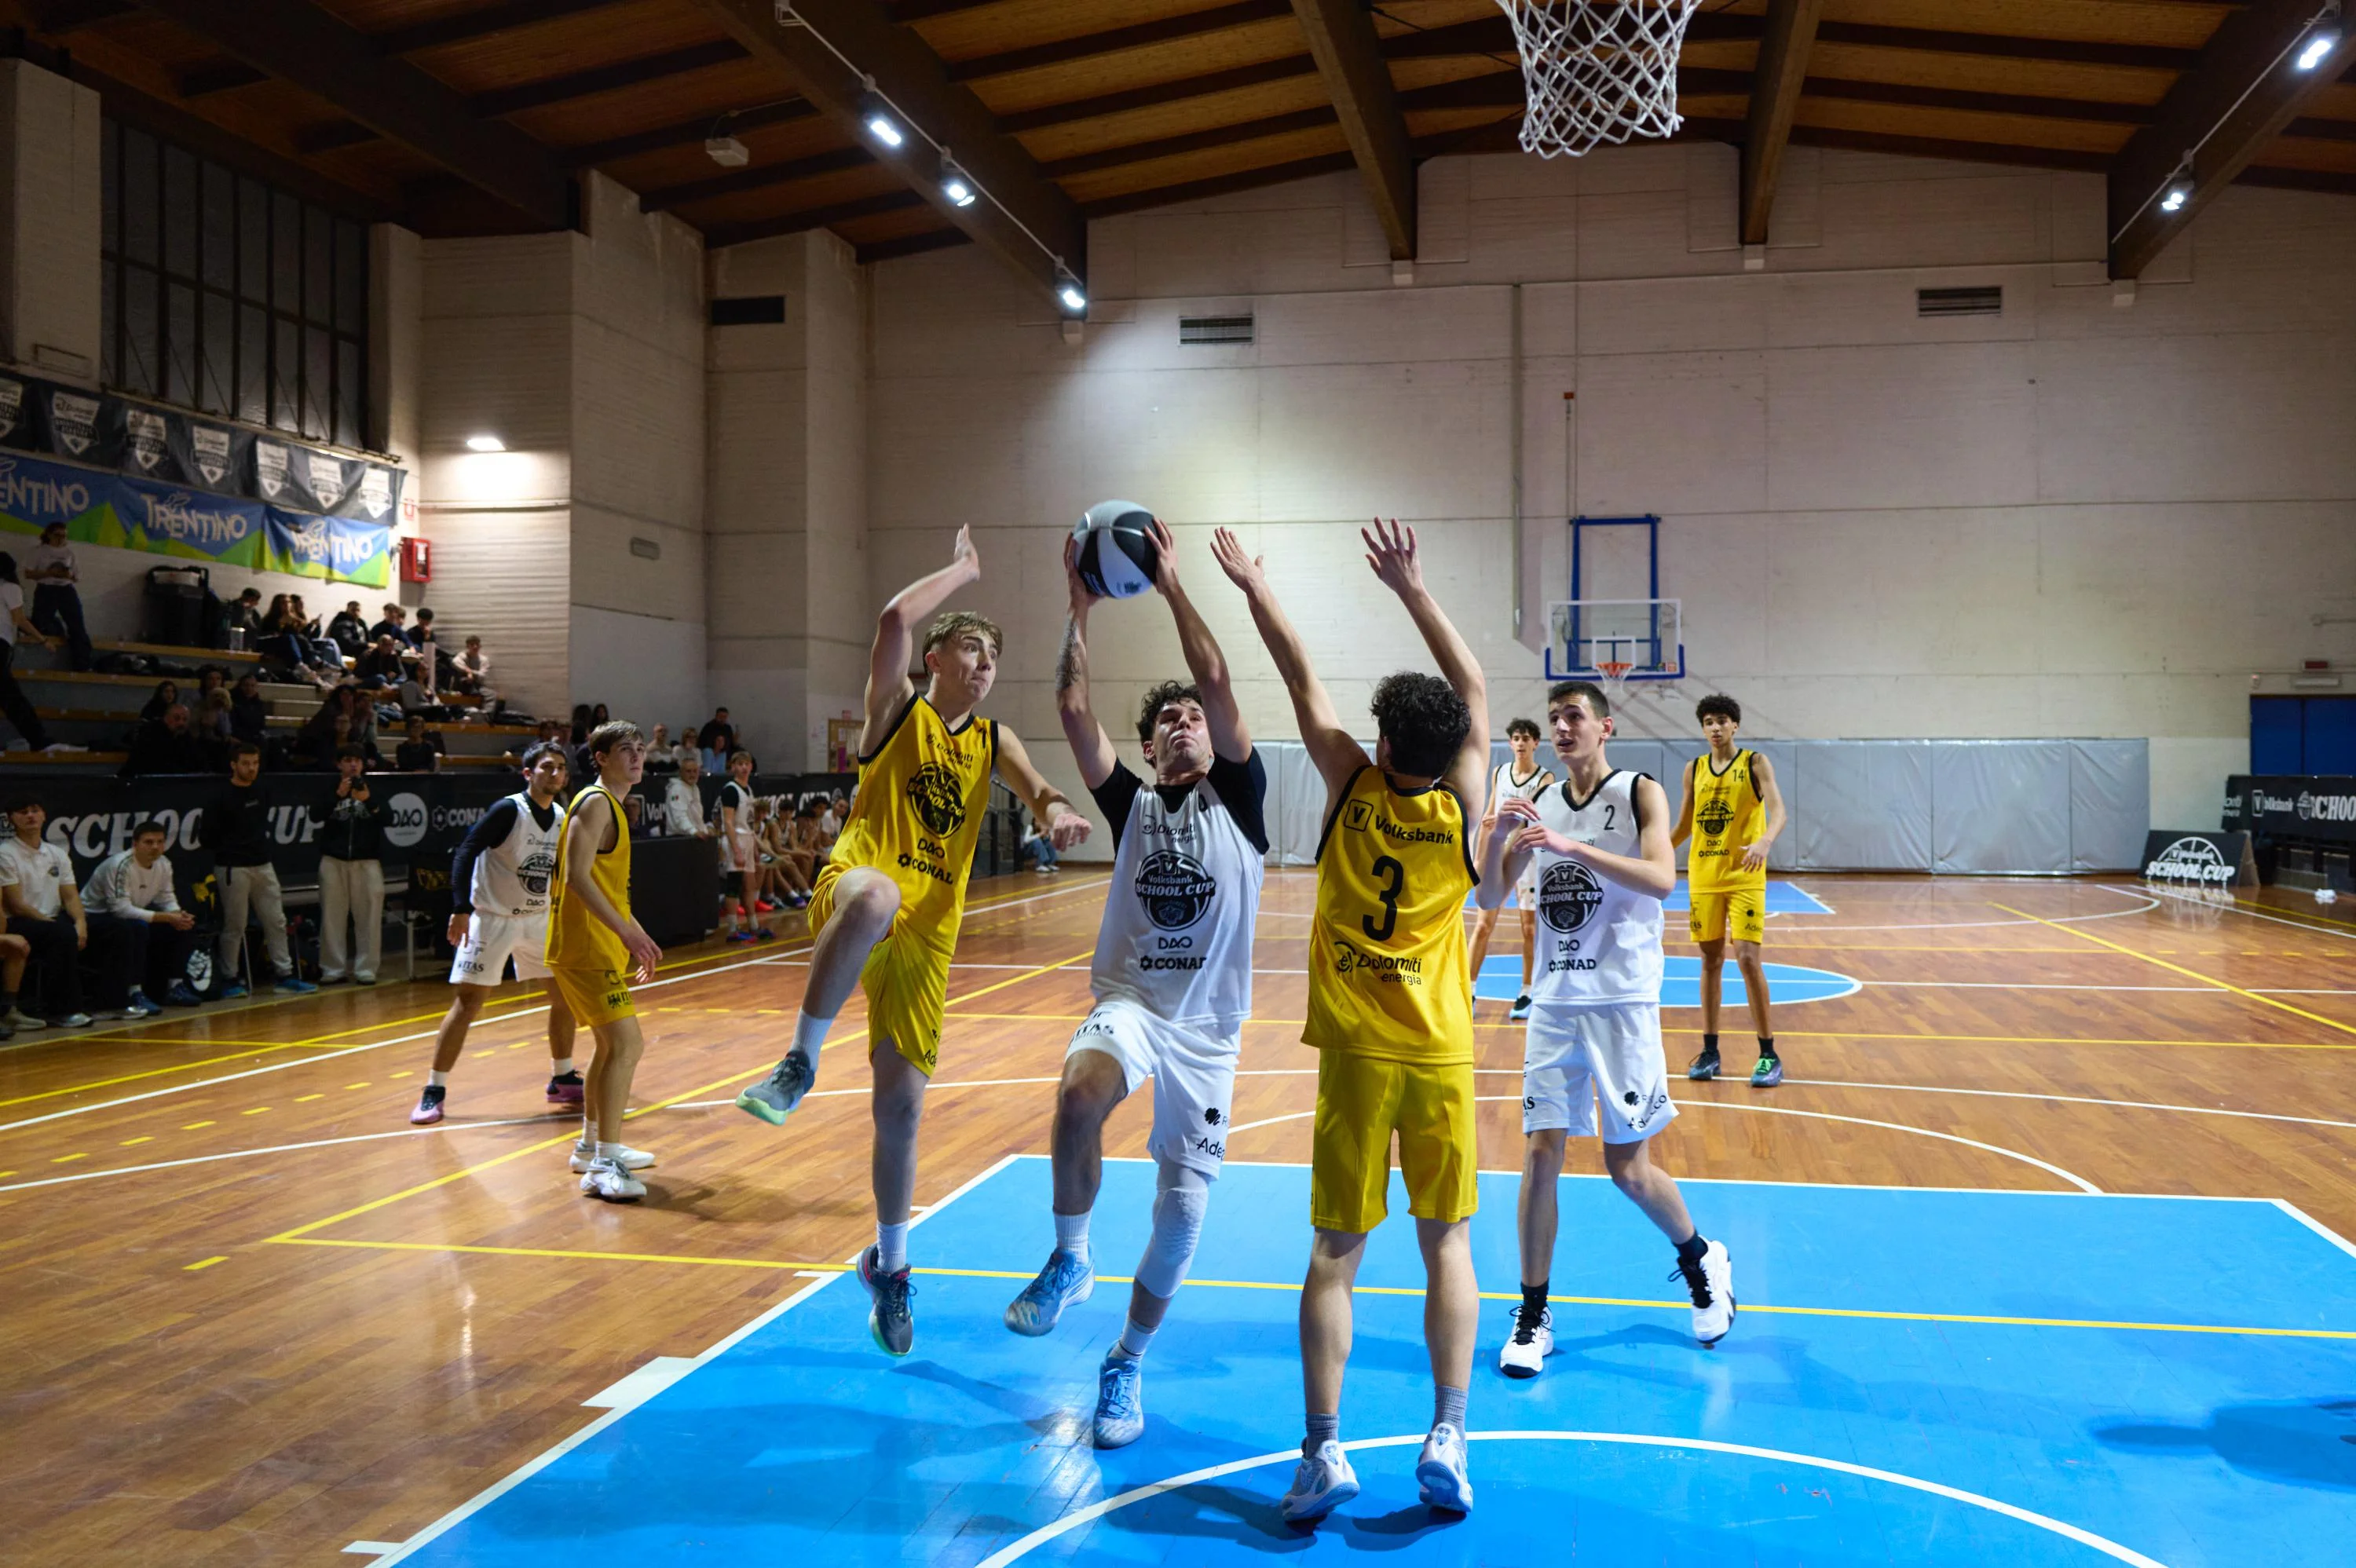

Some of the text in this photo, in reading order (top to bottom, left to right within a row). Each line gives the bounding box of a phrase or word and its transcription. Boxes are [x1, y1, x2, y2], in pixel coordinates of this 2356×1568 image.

[140, 493, 247, 543] TRENTINO
[1732, 769, 1745, 782] 14
[646, 802, 667, 821] Vol
[1604, 805, 1615, 831] 2
[265, 805, 325, 845] UP
[1375, 813, 1454, 846] Volksbank
[1171, 833, 1197, 844] nergia
[917, 838, 946, 859] DAO
[1147, 874, 1193, 884] Volksbank
[2145, 861, 2236, 881] SCHOOL CUP
[1136, 881, 1216, 896] SCHOOL CUP
[1546, 883, 1585, 892] Volksbank
[1576, 891, 1603, 901] CUP
[1363, 855, 1403, 941] 3
[1158, 936, 1193, 949] DAO
[464, 961, 485, 972] ITAS
[1357, 953, 1421, 974] Dolomiti
[1381, 973, 1421, 986] energia
